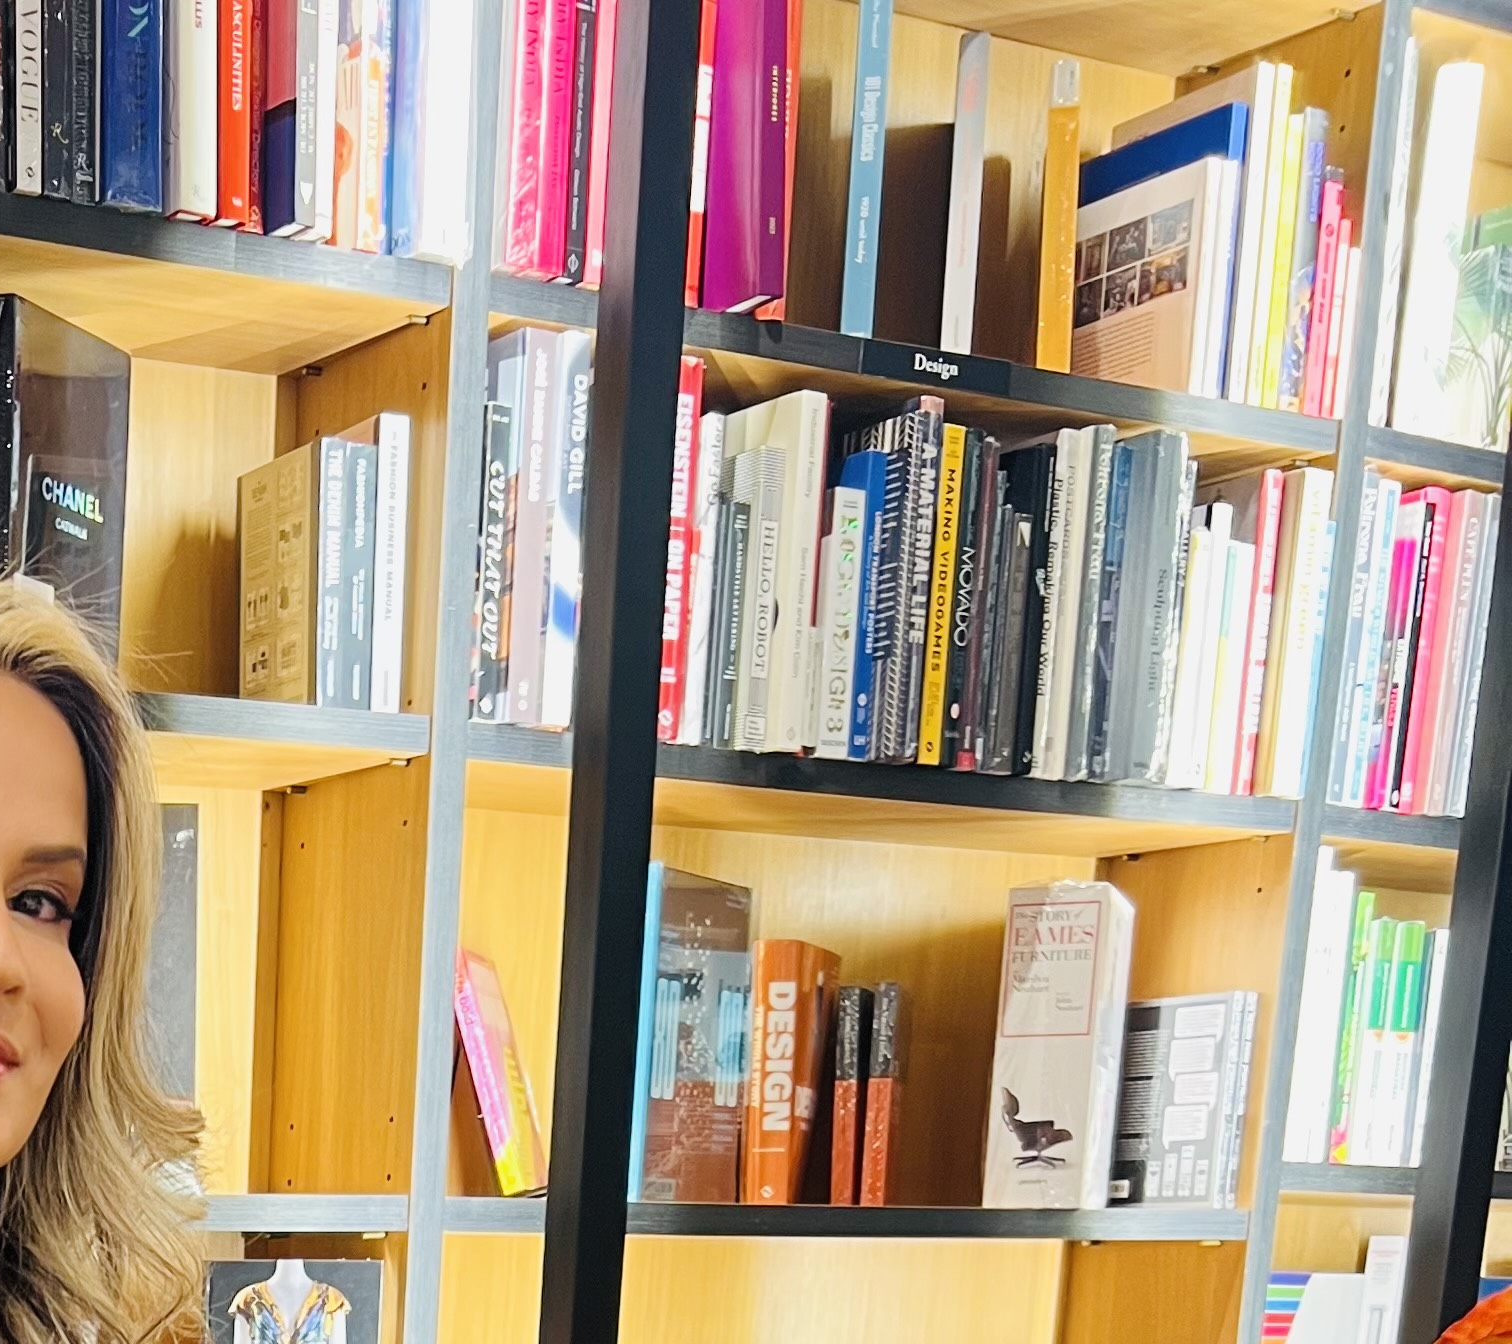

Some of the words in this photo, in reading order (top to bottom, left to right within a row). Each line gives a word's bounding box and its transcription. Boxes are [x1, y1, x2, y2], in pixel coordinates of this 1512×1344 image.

[20, 9, 39, 123] VOGUE
[864, 76, 880, 91] 101
[861, 91, 879, 123] Design
[860, 124, 879, 162] Classics
[913, 353, 959, 380] Design
[571, 374, 588, 442] DAVID
[327, 449, 344, 478] THE
[388, 445, 399, 500] FASHION
[527, 443, 542, 502] CALDAS
[567, 447, 586, 494] GILL
[670, 393, 694, 518] EISENSTEIN
[921, 443, 938, 460] A
[41, 476, 105, 524] CHANEL
[326, 479, 343, 526] DENIM
[354, 458, 367, 548] FASHIONPEDIA
[487, 460, 506, 519] CUT
[805, 461, 816, 499] Facility
[941, 468, 958, 543] MAKING
[386, 505, 396, 566] BUSINESS
[872, 511, 882, 554] LONDON
[912, 468, 937, 587] MATERIAL
[1061, 464, 1076, 560] POSTCARDS
[325, 529, 342, 588] MANUAL
[484, 522, 505, 600] THAT
[666, 539, 685, 569] ON
[758, 526, 775, 599] HELLO,
[1043, 540, 1059, 615] Remaking
[383, 570, 394, 622] MANUAL
[662, 573, 683, 640] PAPER
[868, 555, 880, 612] TRANSPORT
[954, 546, 976, 647] MOVADO
[1351, 572, 1369, 619] Frau
[481, 601, 499, 660] OUT
[864, 612, 875, 655] POSTERS
[908, 593, 927, 644] LIFE
[930, 550, 951, 673] VIDEOGAMES
[1041, 619, 1052, 647] Our
[1036, 651, 1050, 697] World
[826, 717, 844, 733] 3
[1011, 948, 1093, 964] FURNITURE
[1014, 925, 1096, 946] EAMES
[761, 980, 798, 1131] DESIGN
